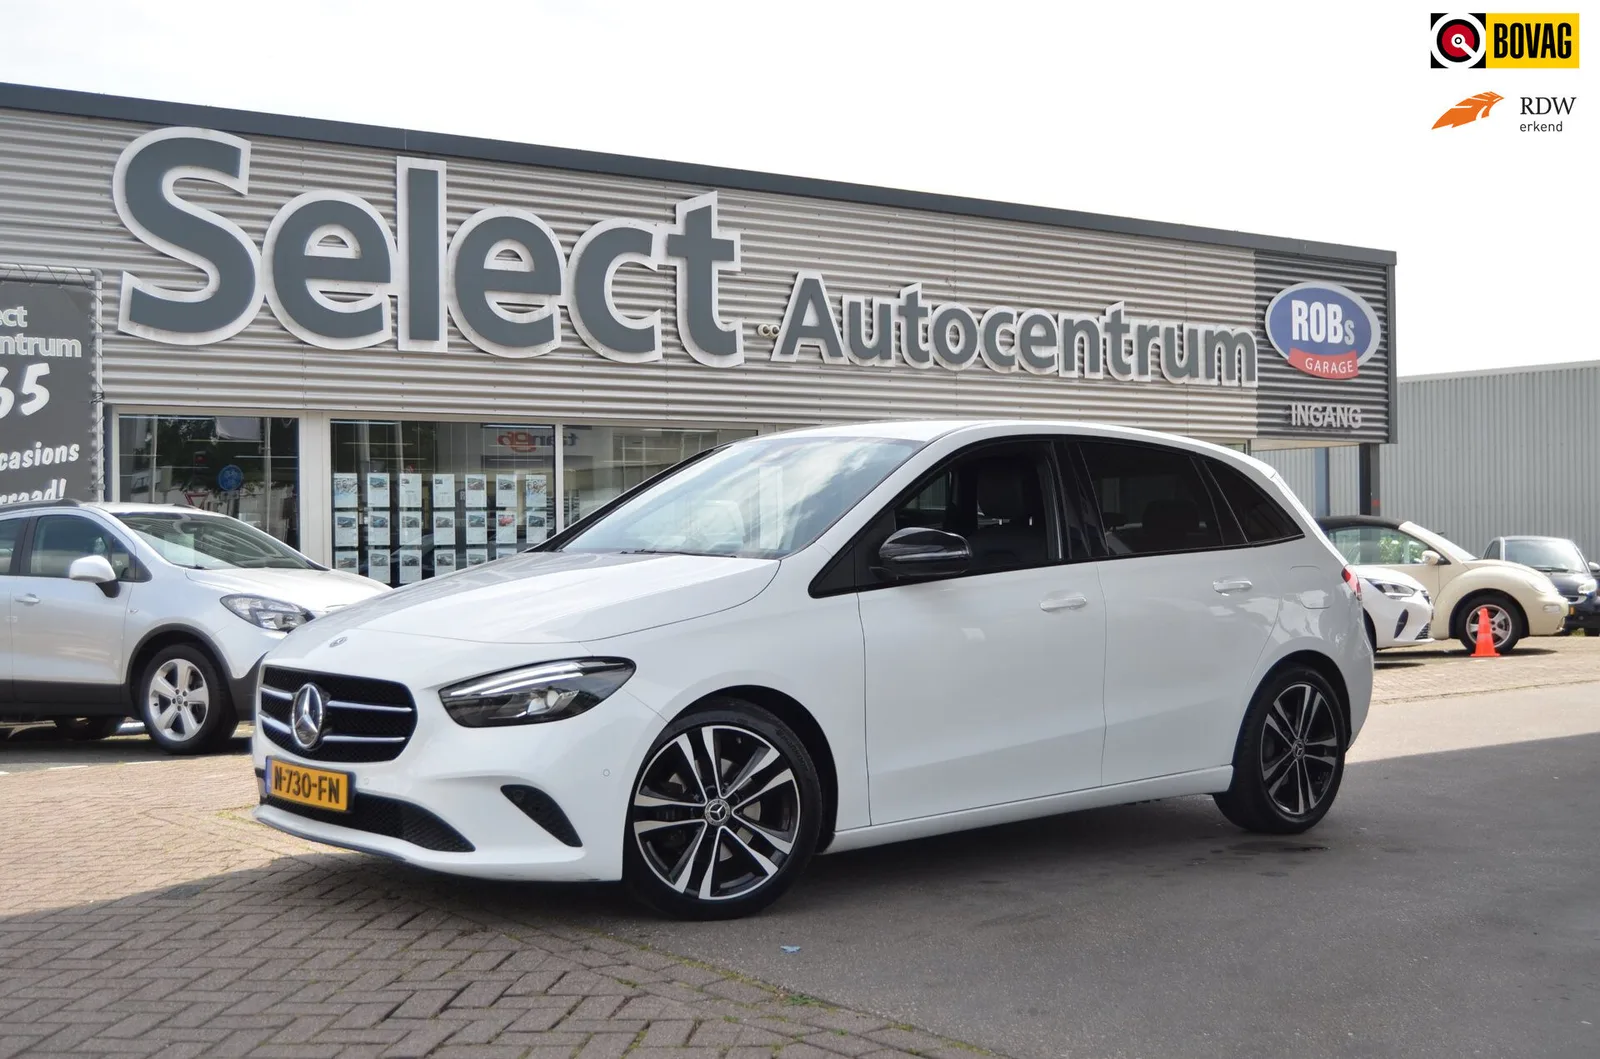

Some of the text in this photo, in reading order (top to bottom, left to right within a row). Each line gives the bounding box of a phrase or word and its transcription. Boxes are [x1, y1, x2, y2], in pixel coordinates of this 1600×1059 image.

[113, 127, 1259, 388] Select Autocentrum
[0, 306, 28, 328] ct
[1305, 357, 1354, 374] GARAGE
[1290, 402, 1362, 429] INGANG
[274, 765, 340, 804] N-730-FN
